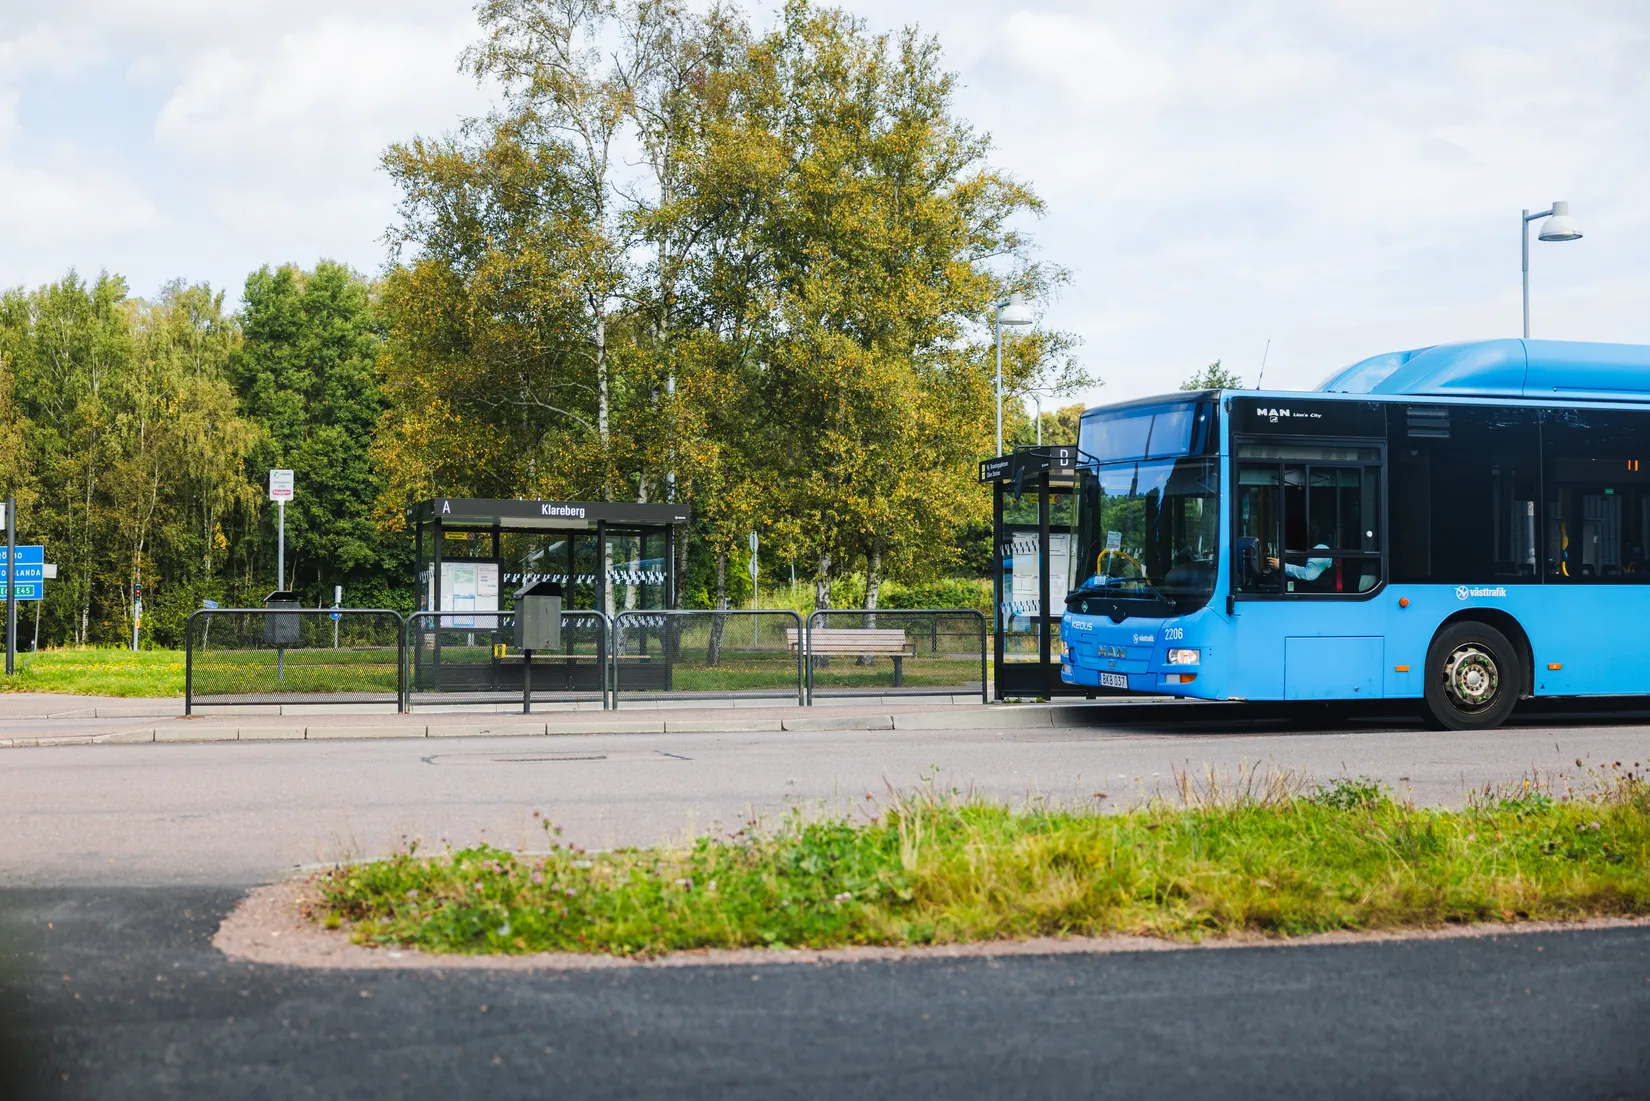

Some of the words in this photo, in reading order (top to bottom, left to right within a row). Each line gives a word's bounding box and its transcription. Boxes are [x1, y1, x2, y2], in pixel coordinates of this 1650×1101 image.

[1256, 408, 1291, 417] MAN
[1060, 449, 1069, 466] D
[442, 500, 451, 514] A
[541, 503, 586, 519] Klareberg
[1469, 586, 1507, 597] västtrafik
[1164, 627, 1183, 641] 2206
[1102, 673, 1114, 685] BKB
